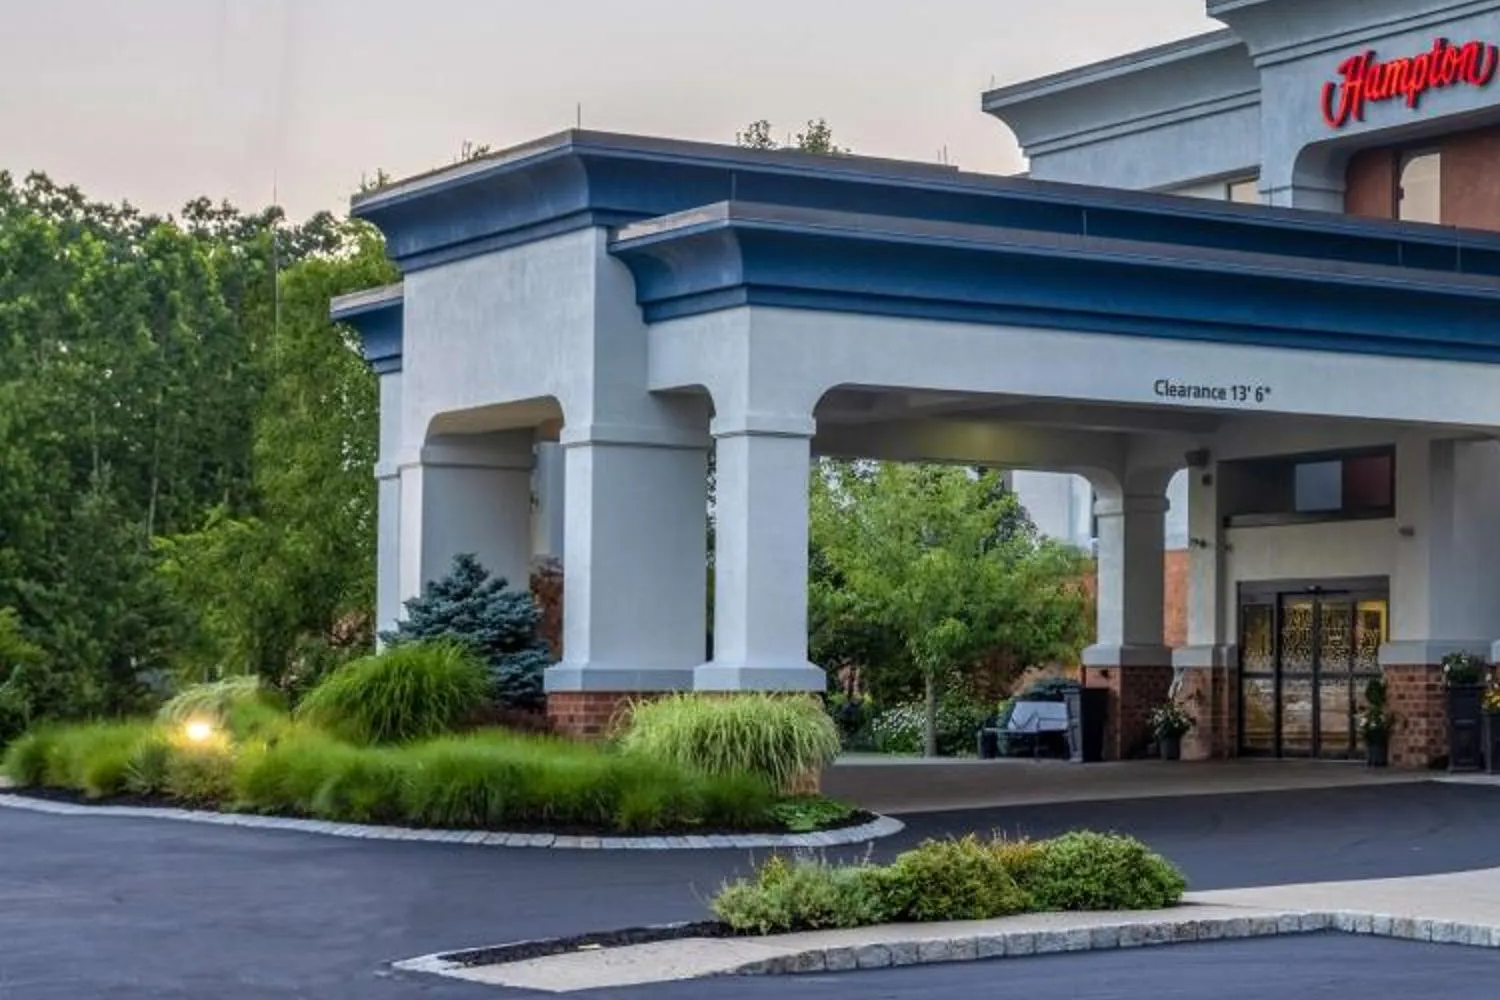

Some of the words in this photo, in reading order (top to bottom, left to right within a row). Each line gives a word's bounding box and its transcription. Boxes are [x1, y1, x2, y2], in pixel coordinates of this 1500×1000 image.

[1320, 37, 1498, 128] Hampton
[1154, 379, 1226, 400] Clearance
[1231, 384, 1251, 402] 13'
